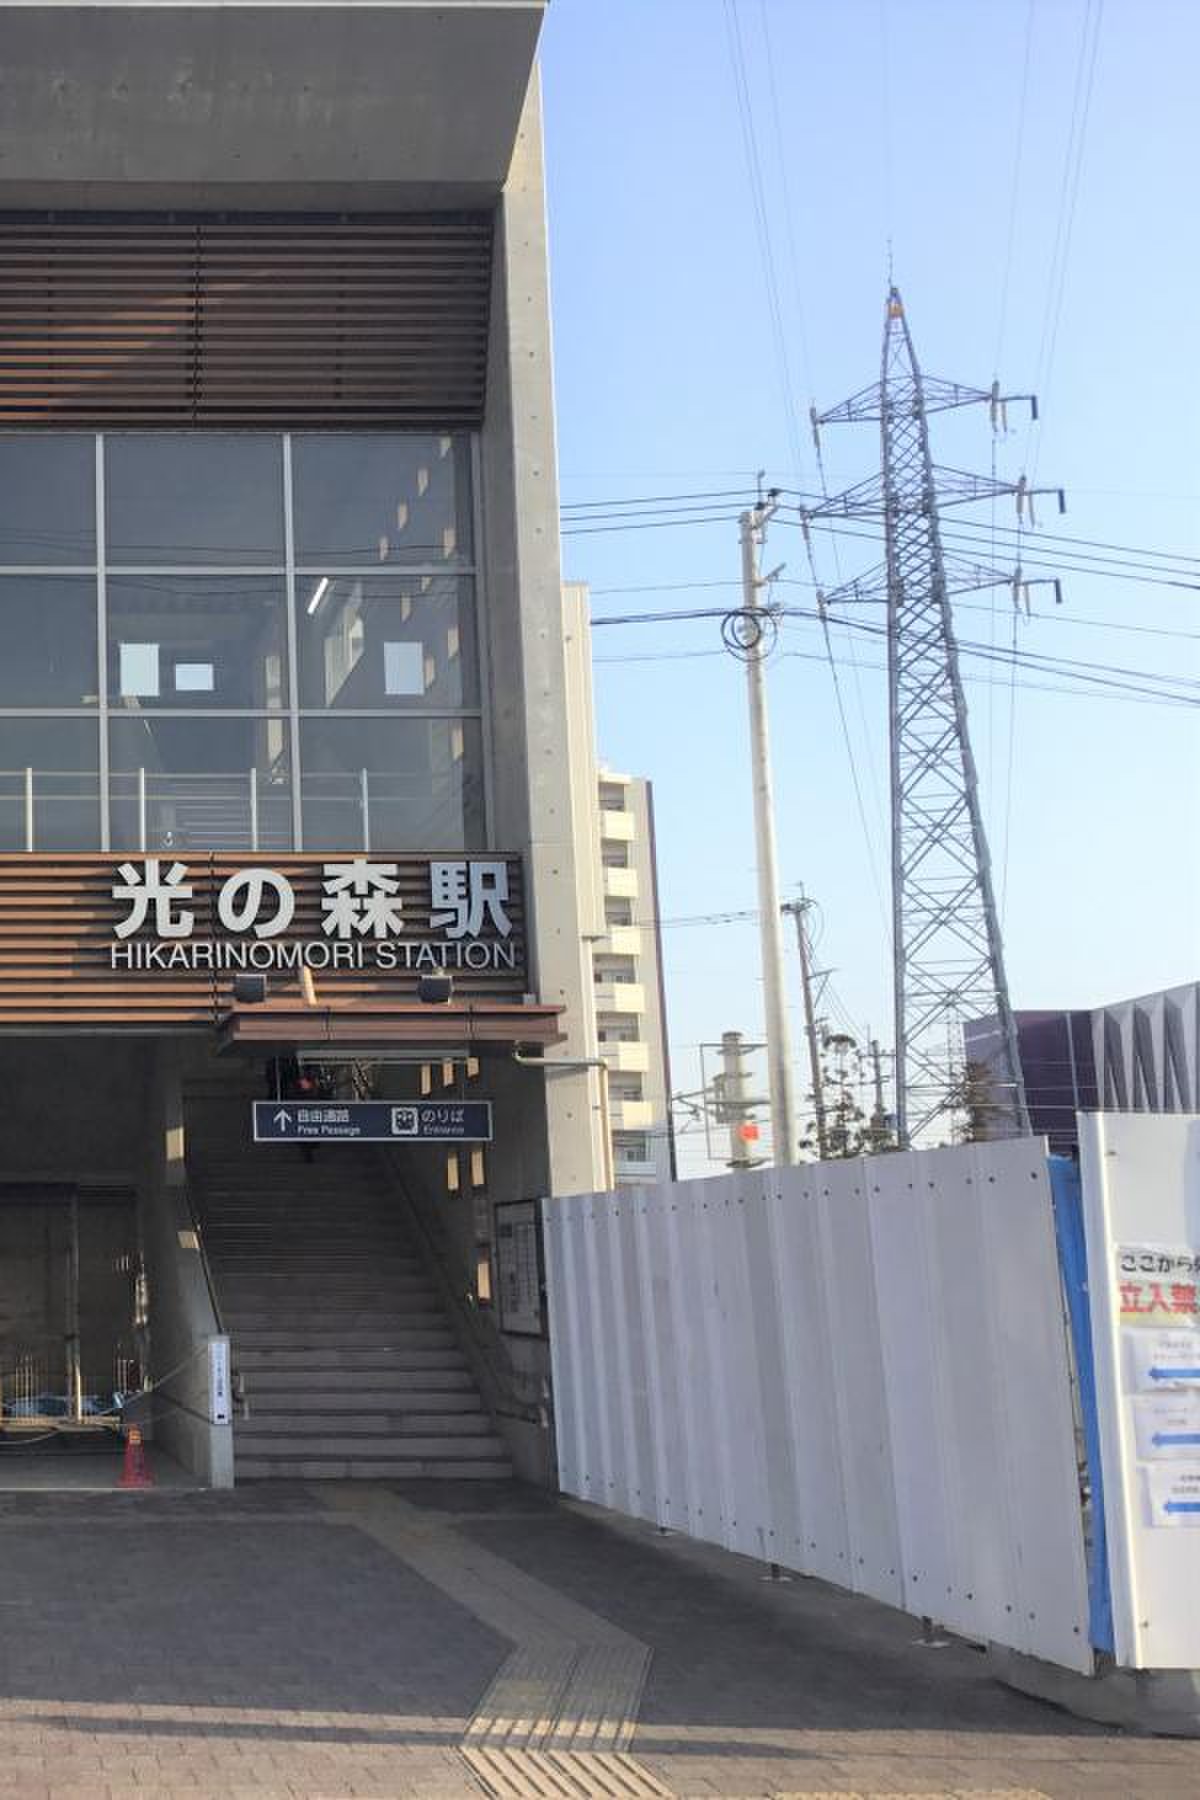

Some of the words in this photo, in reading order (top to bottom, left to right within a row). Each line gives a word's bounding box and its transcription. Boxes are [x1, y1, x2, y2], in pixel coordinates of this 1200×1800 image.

[112, 859, 512, 938] 光の森駅
[111, 942, 363, 969] HIKARINOMORI
[377, 942, 515, 969] STATION
[422, 1109, 465, 1123] のりば
